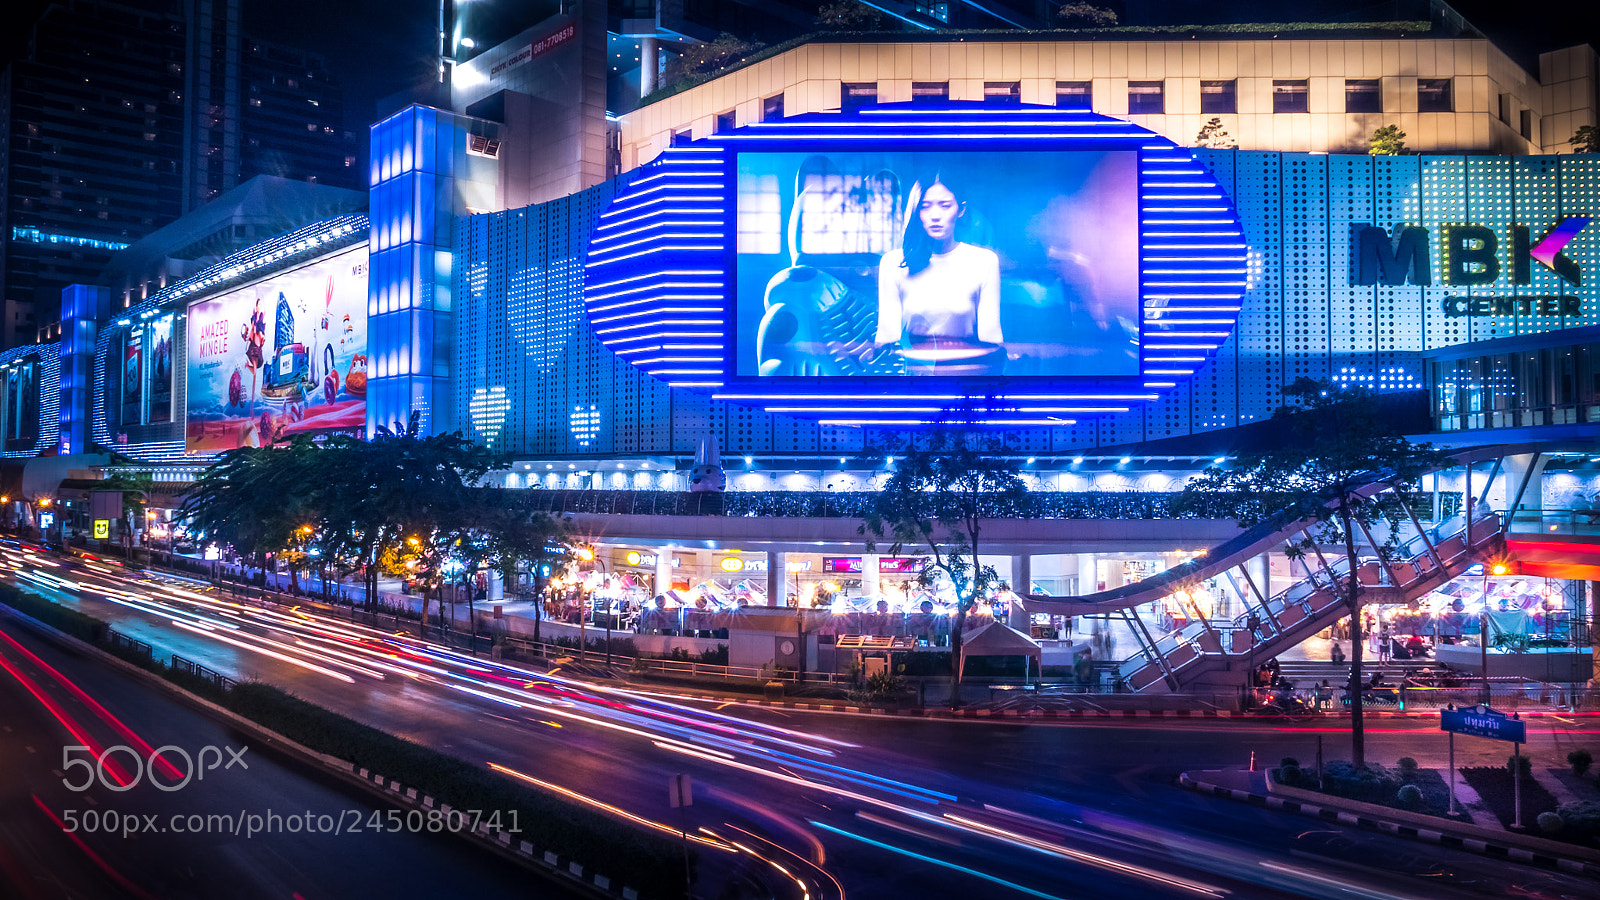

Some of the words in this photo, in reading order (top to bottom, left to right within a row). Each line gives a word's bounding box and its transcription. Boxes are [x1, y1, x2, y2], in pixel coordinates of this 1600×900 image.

[508, 49, 531, 66] COLOUR
[1348, 215, 1593, 287] MBK
[1441, 295, 1582, 316] CENTER
[200, 320, 228, 341] AMAZED
[200, 337, 228, 358] MINGLE
[1464, 716, 1500, 729] ปทุมวัน
